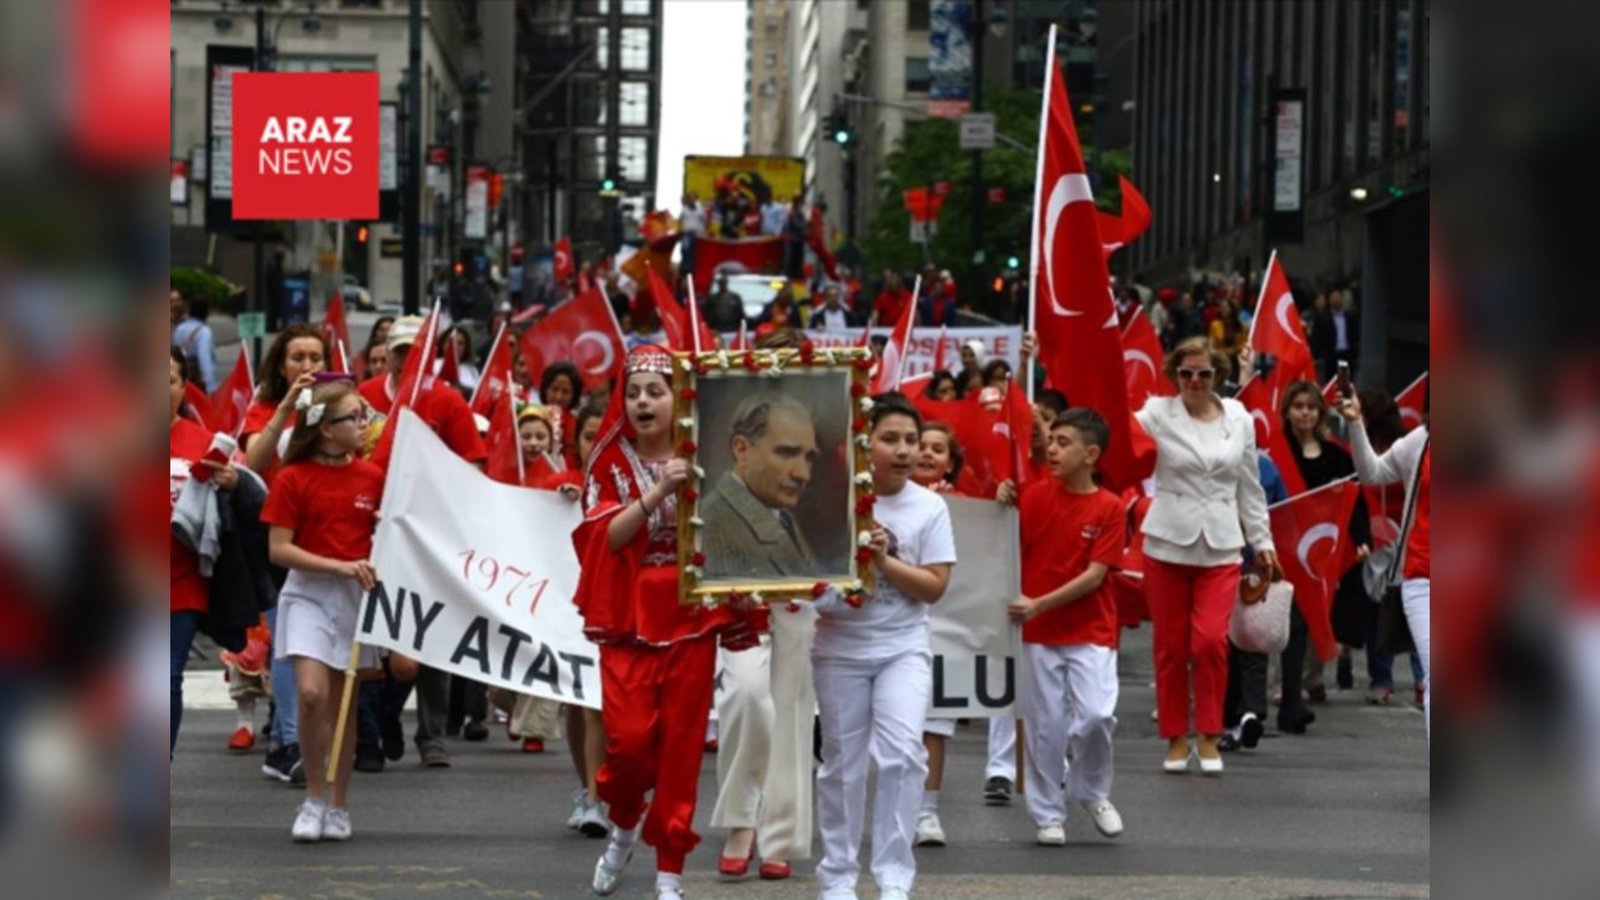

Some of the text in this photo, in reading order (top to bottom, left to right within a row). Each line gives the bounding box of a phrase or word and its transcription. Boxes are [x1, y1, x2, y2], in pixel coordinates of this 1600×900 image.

[457, 547, 550, 617] 1971
[361, 581, 1015, 708] NY ATAT LU
